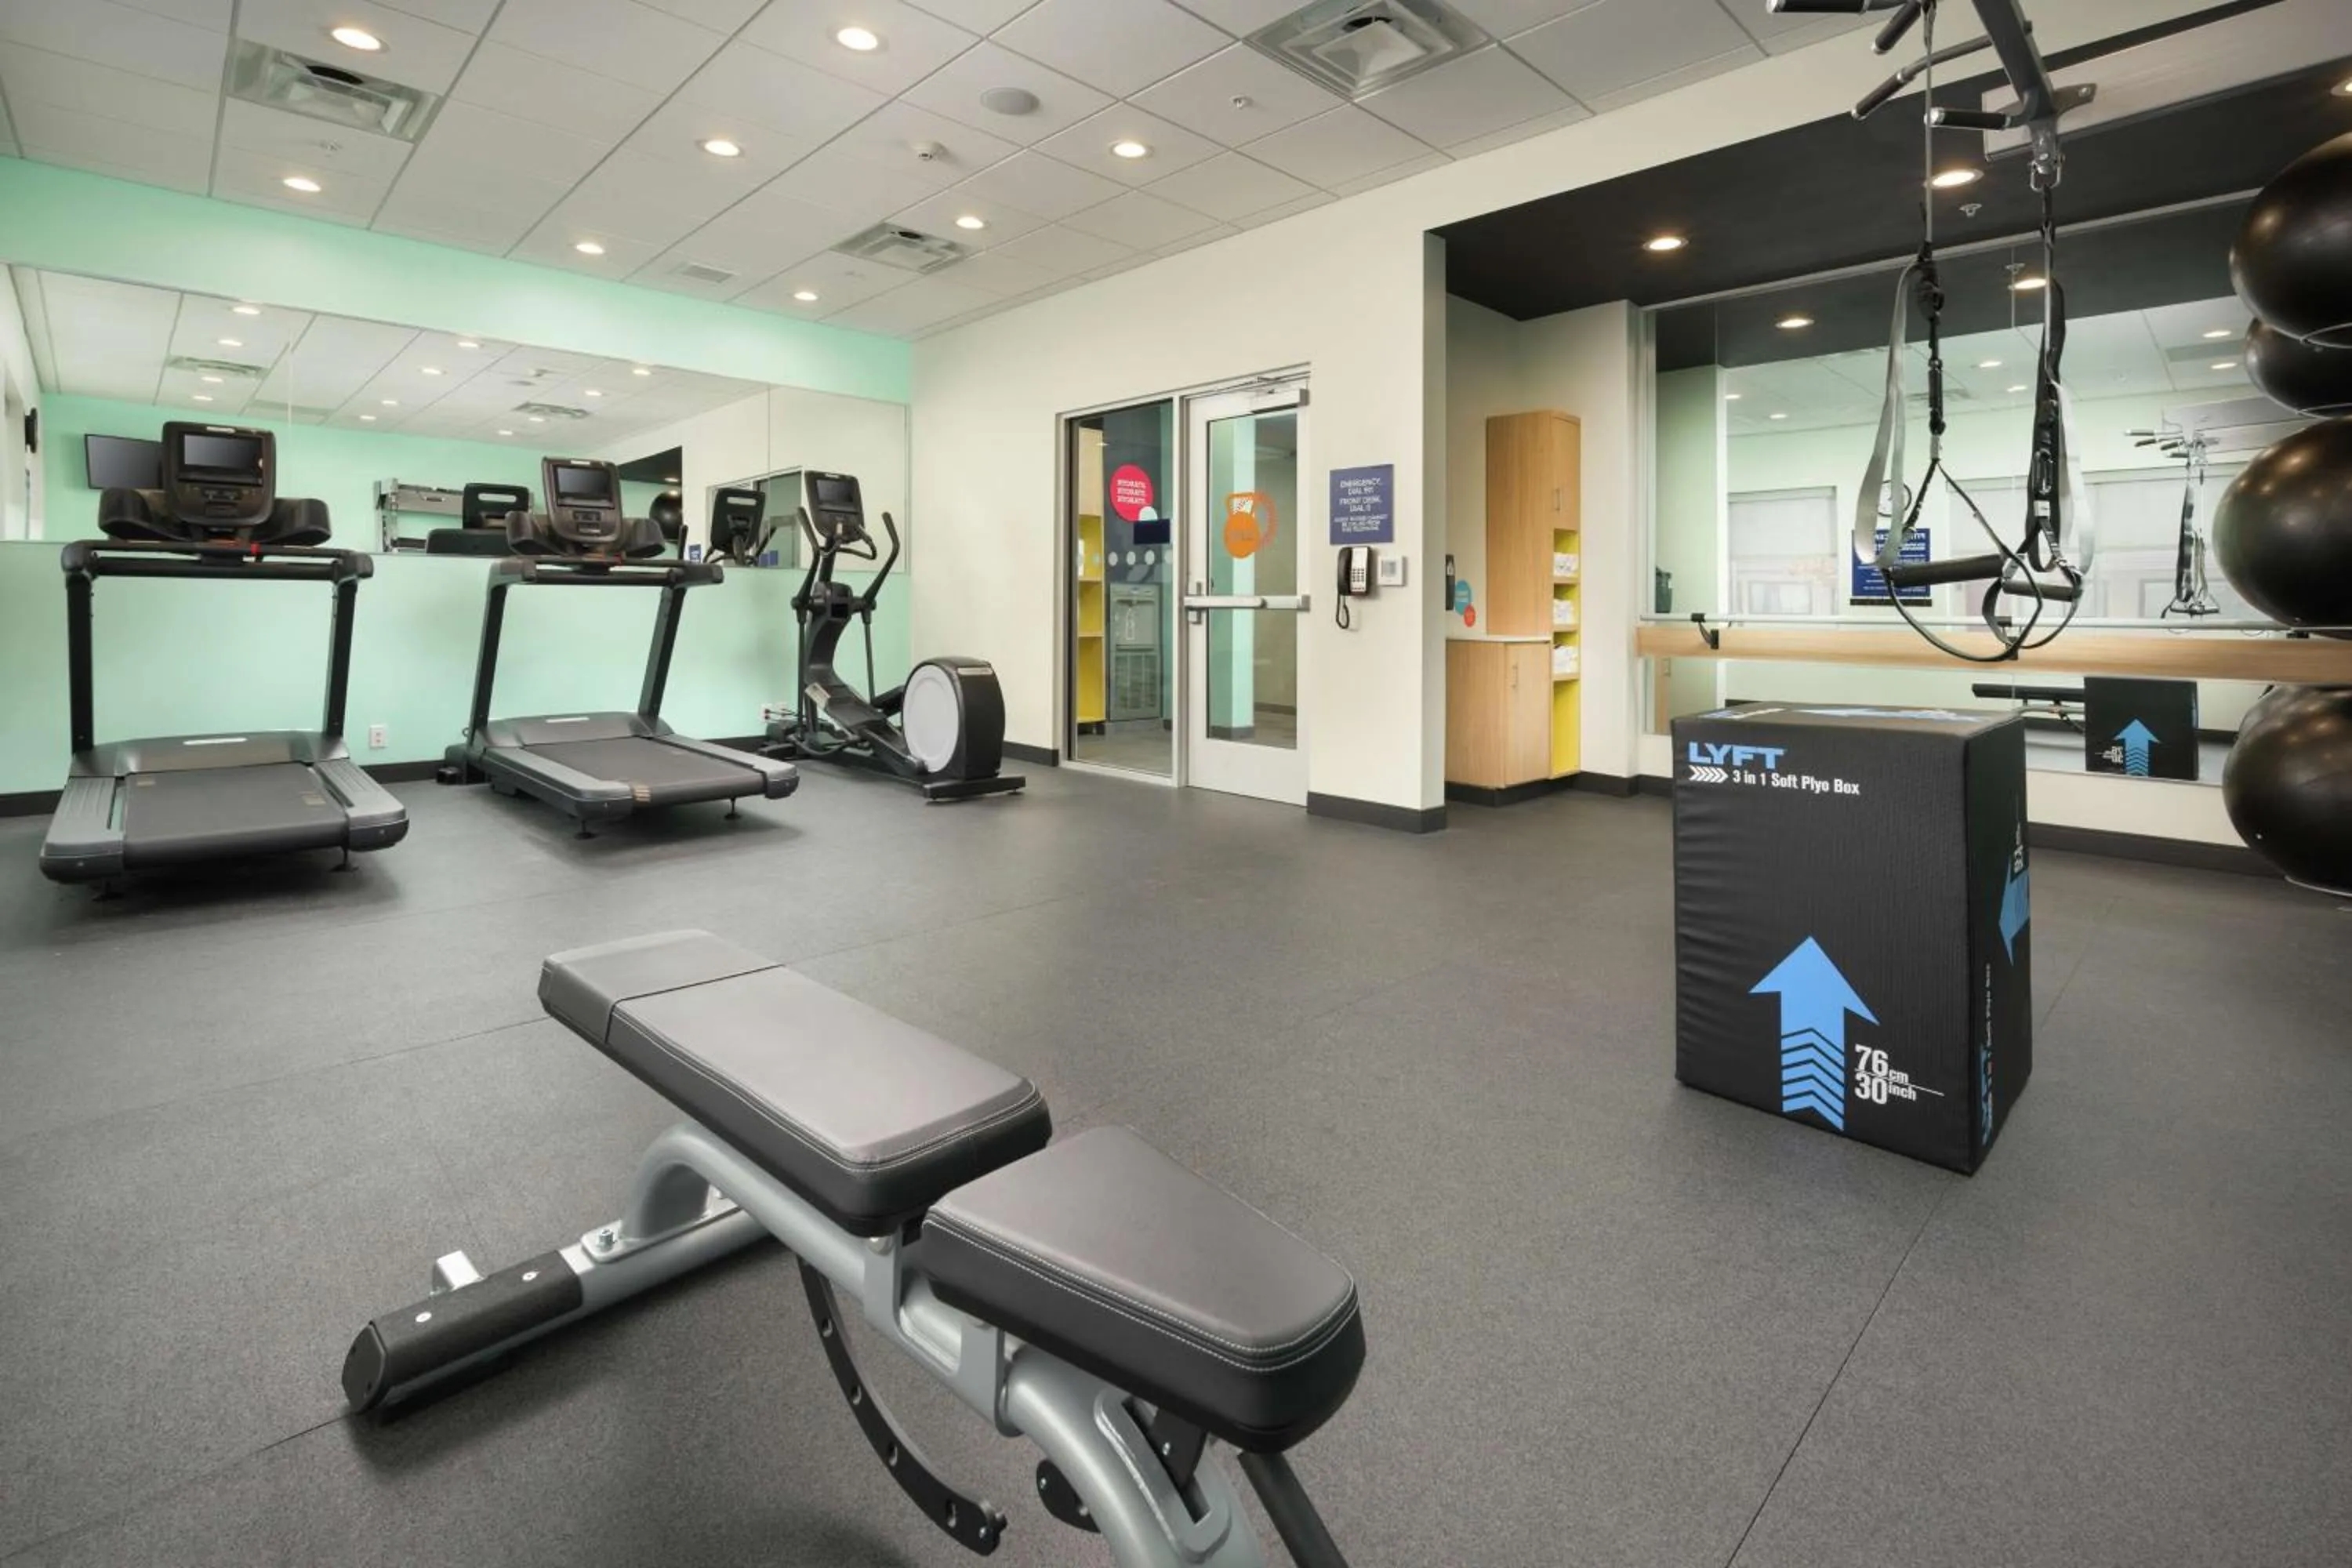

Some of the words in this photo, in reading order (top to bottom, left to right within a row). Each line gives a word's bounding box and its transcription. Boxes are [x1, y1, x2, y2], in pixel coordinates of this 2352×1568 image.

[1689, 742, 1787, 769] LYFT
[1733, 770, 1741, 783] 3
[1744, 771, 1755, 784] in
[1760, 773, 1766, 786] 1
[1771, 773, 1798, 789] Soft
[1802, 775, 1829, 793] Plyo
[1835, 779, 1860, 795] Box
[1854, 1044, 1889, 1077] 76
[1889, 1069, 1909, 1084] cm
[1854, 1072, 1888, 1105] 30
[1888, 1082, 1917, 1101] inch
